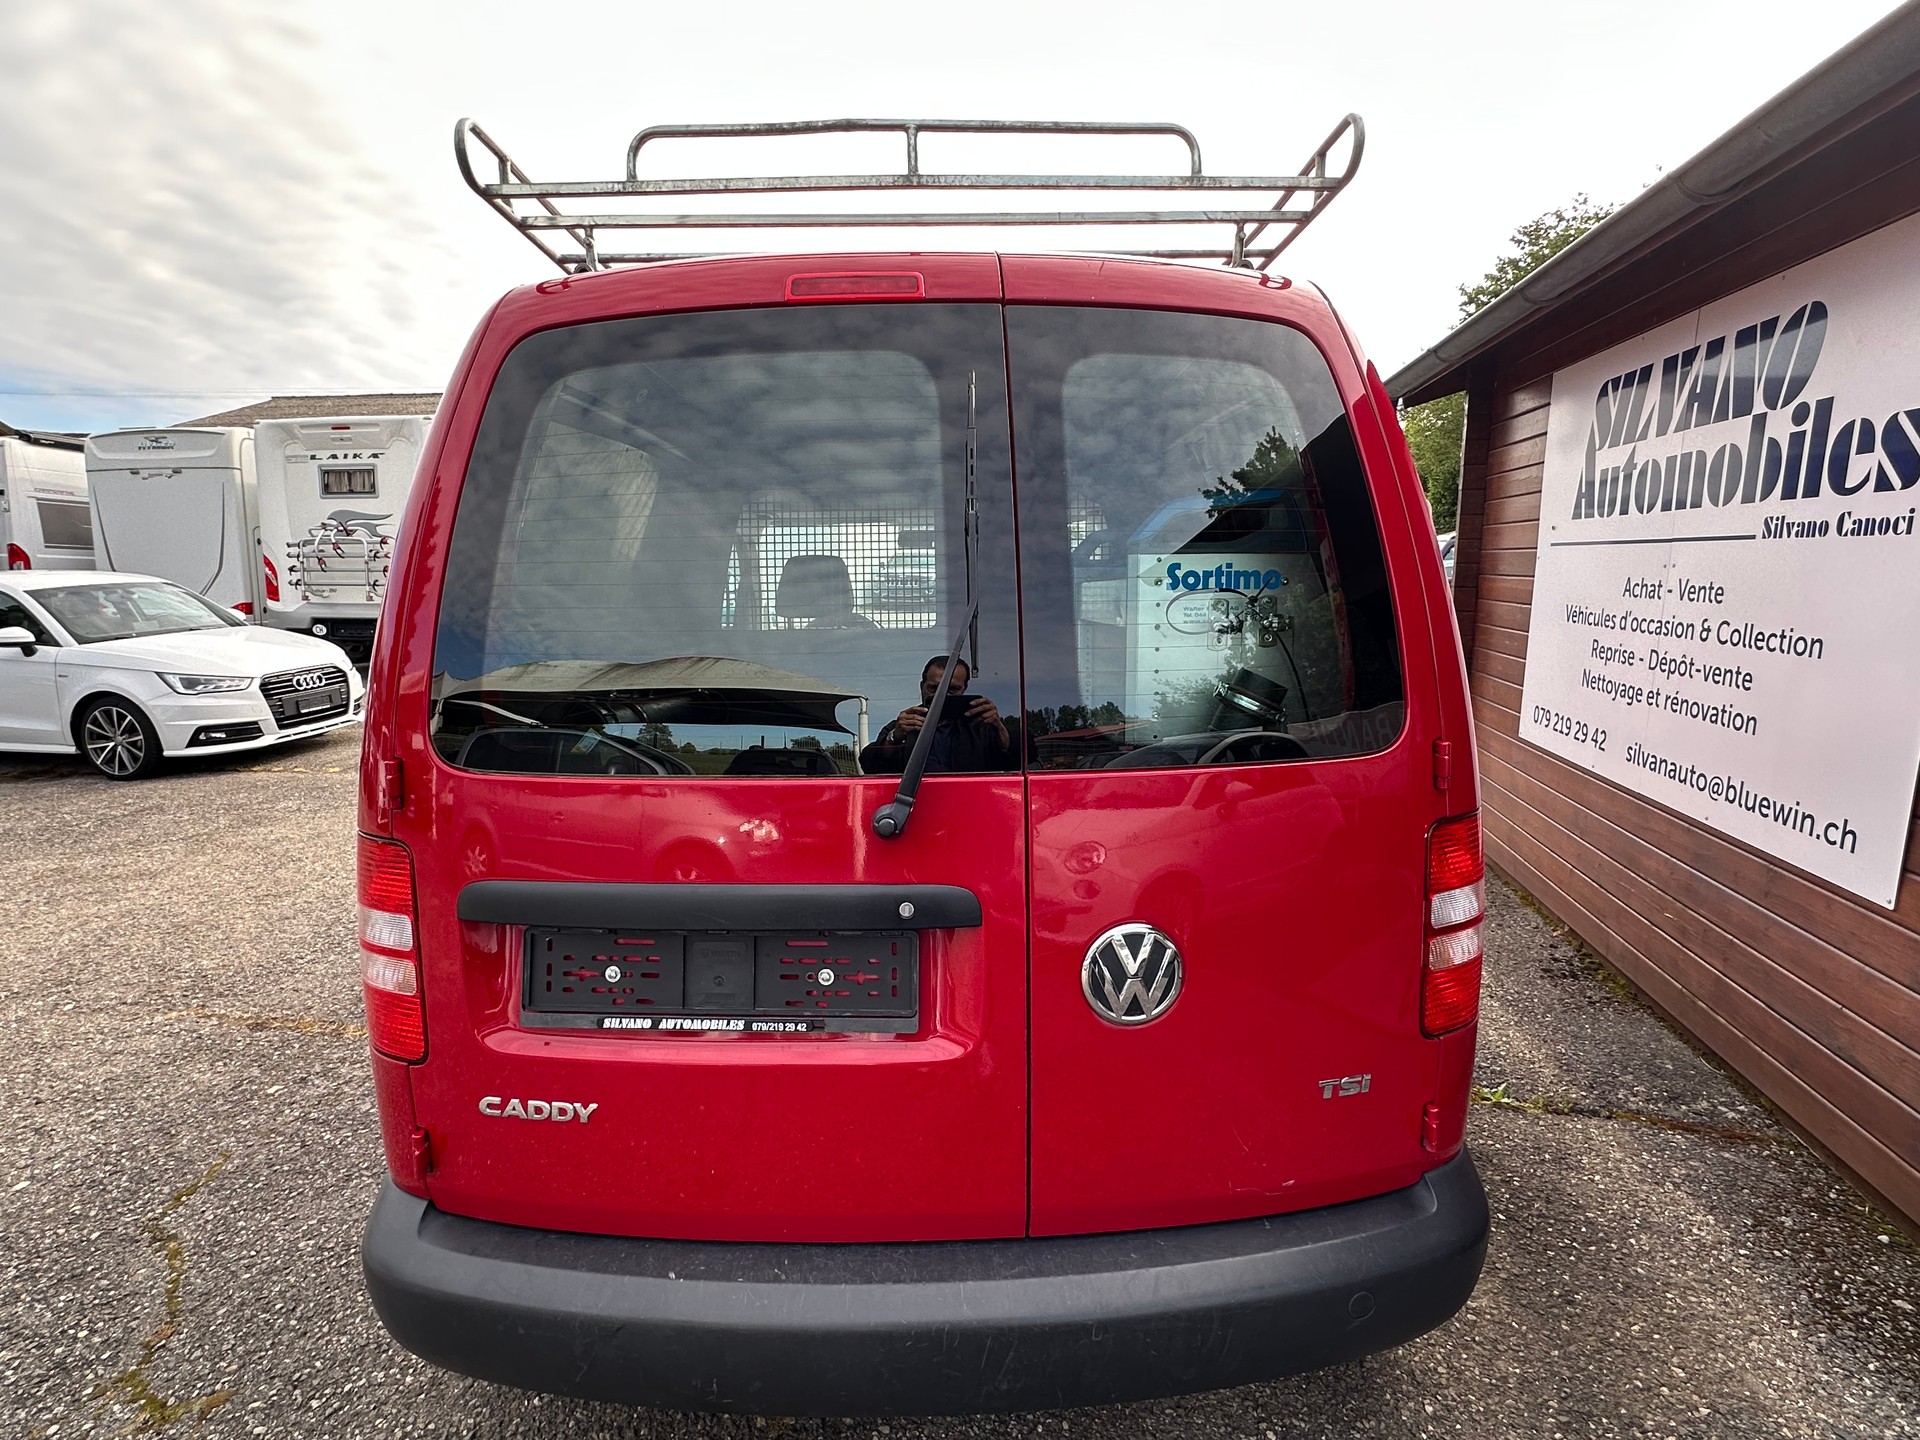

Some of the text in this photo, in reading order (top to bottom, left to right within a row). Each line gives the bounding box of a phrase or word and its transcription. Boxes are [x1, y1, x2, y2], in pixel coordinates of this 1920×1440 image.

[1595, 300, 1829, 451] SILVANO
[310, 452, 385, 461] LAIKA
[1571, 395, 1920, 520] Automobiles
[1761, 507, 1916, 540] Silvano Canoci
[1166, 562, 1281, 591] Sortimo
[1622, 576, 1663, 599] Achat
[1678, 578, 1725, 604] Vente
[1565, 604, 1824, 659] Véhicules d'occasion & Collection
[1591, 638, 1635, 667] Reprise
[1648, 648, 1753, 691] Dépôt-vente
[1581, 668, 1758, 736] Nettoyage et rénovation
[1533, 705, 1608, 752] 079 219 29 42
[1625, 742, 1858, 854] silvanauto@bluewin.ch
[603, 1017, 807, 1032] SILVANO AUTOMOBILES 079/219 29 42
[479, 1096, 599, 1123] CADDY
